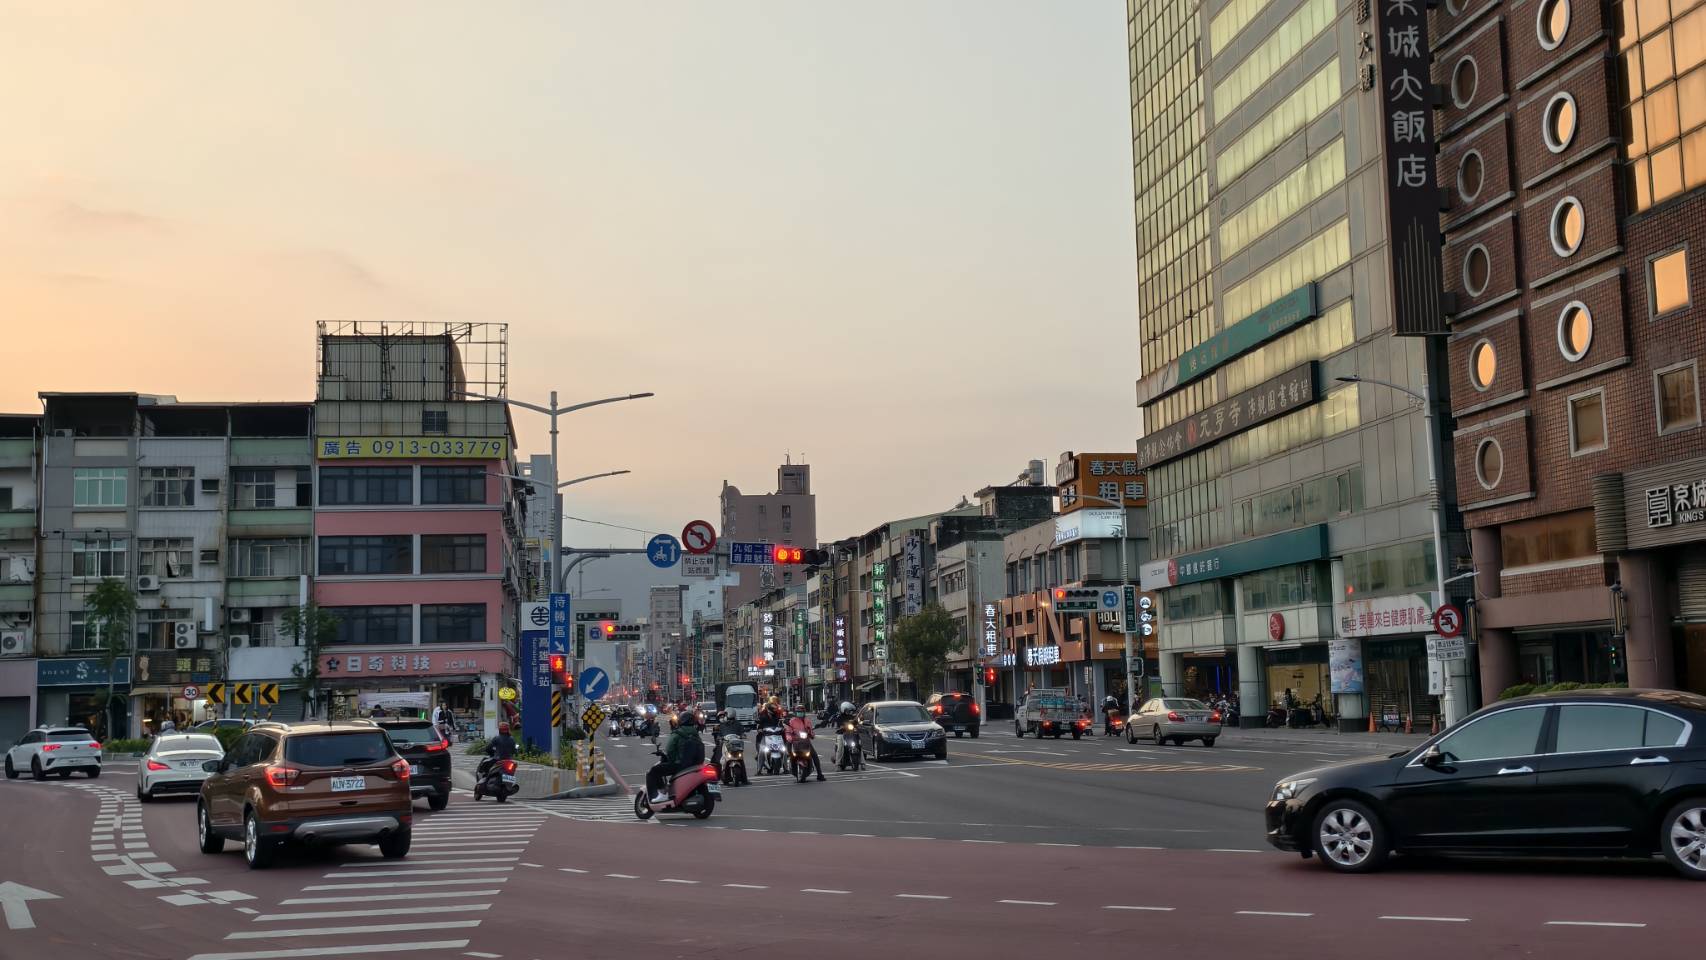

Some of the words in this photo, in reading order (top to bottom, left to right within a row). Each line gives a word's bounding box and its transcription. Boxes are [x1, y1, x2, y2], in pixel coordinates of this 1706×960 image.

[323, 440, 361, 456] 廣告
[372, 440, 501, 455] 0913-033779
[1099, 480, 1145, 500] 租車
[554, 596, 566, 638] 待轉區
[984, 604, 997, 656] 春天租車
[347, 655, 430, 672] 日奇科技
[186, 688, 196, 696] 30
